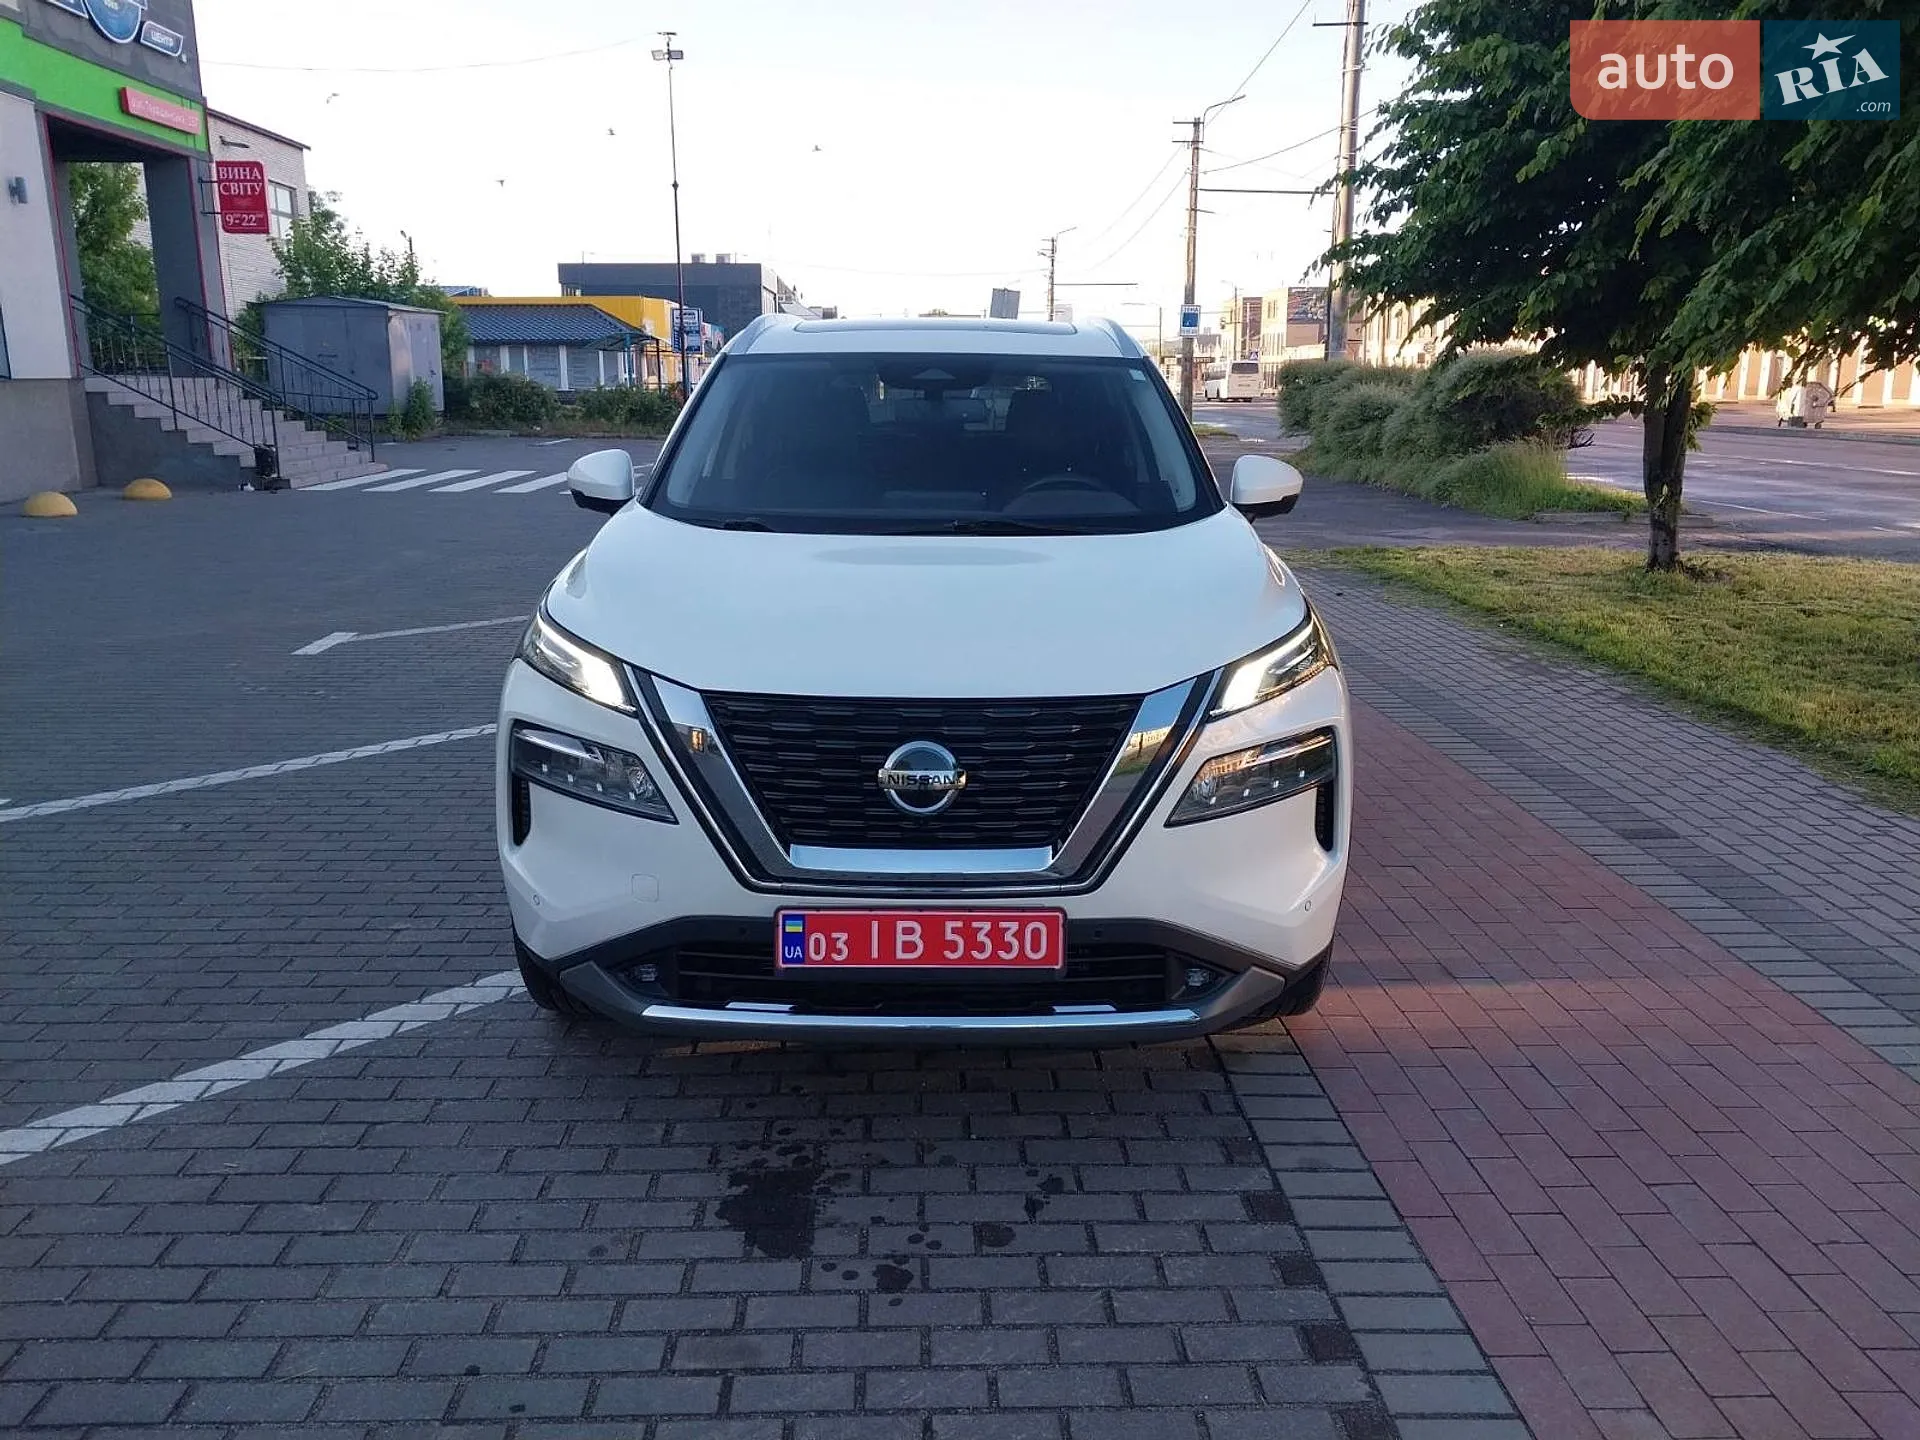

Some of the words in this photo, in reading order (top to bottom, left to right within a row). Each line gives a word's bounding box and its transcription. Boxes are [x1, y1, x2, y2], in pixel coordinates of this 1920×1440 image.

[218, 166, 262, 180] ВИНА
[219, 182, 263, 196] СВІТУ
[887, 774, 955, 786] NISSAN
[808, 932, 850, 961] 03
[943, 920, 1048, 961] 5330
[784, 945, 803, 960] UA
